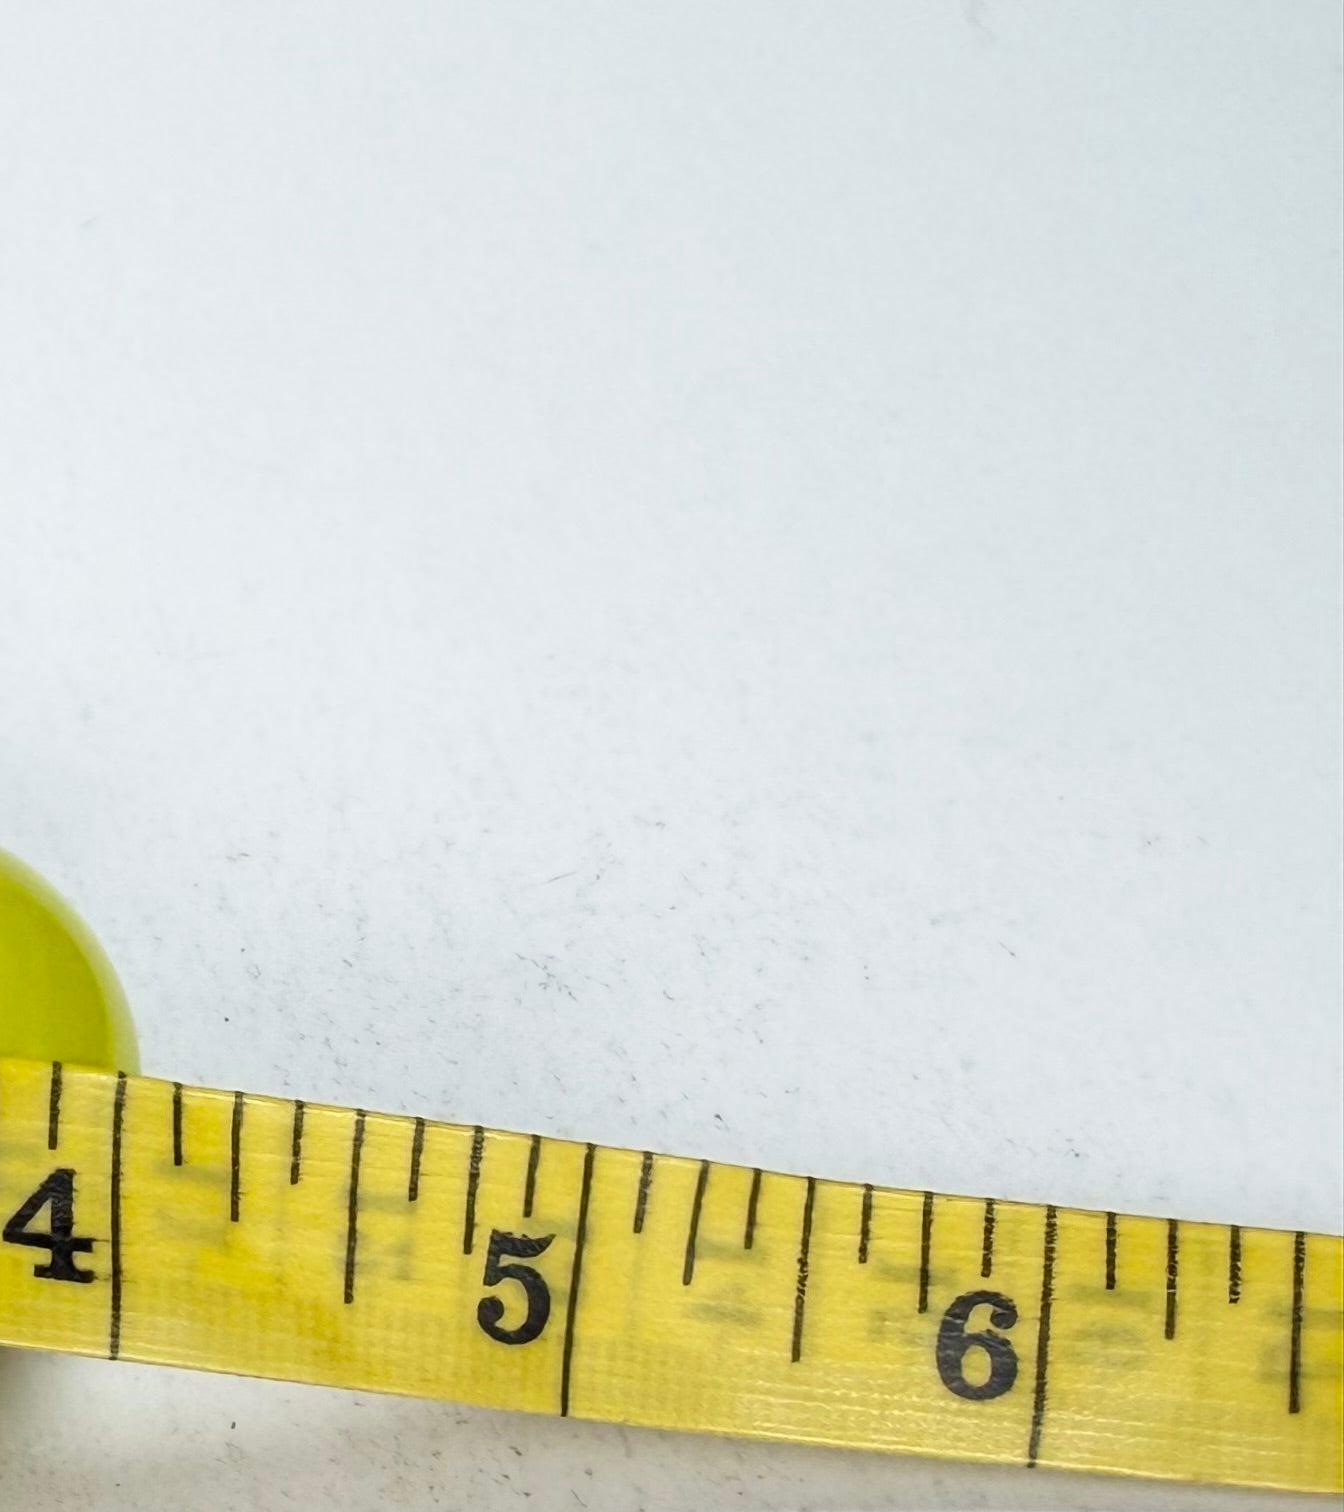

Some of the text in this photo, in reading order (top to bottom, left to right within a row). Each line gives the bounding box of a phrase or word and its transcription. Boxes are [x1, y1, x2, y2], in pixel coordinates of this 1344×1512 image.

[1, 1168, 99, 1284] 4
[477, 1229, 556, 1346] 5
[936, 1290, 1019, 1401] 6
